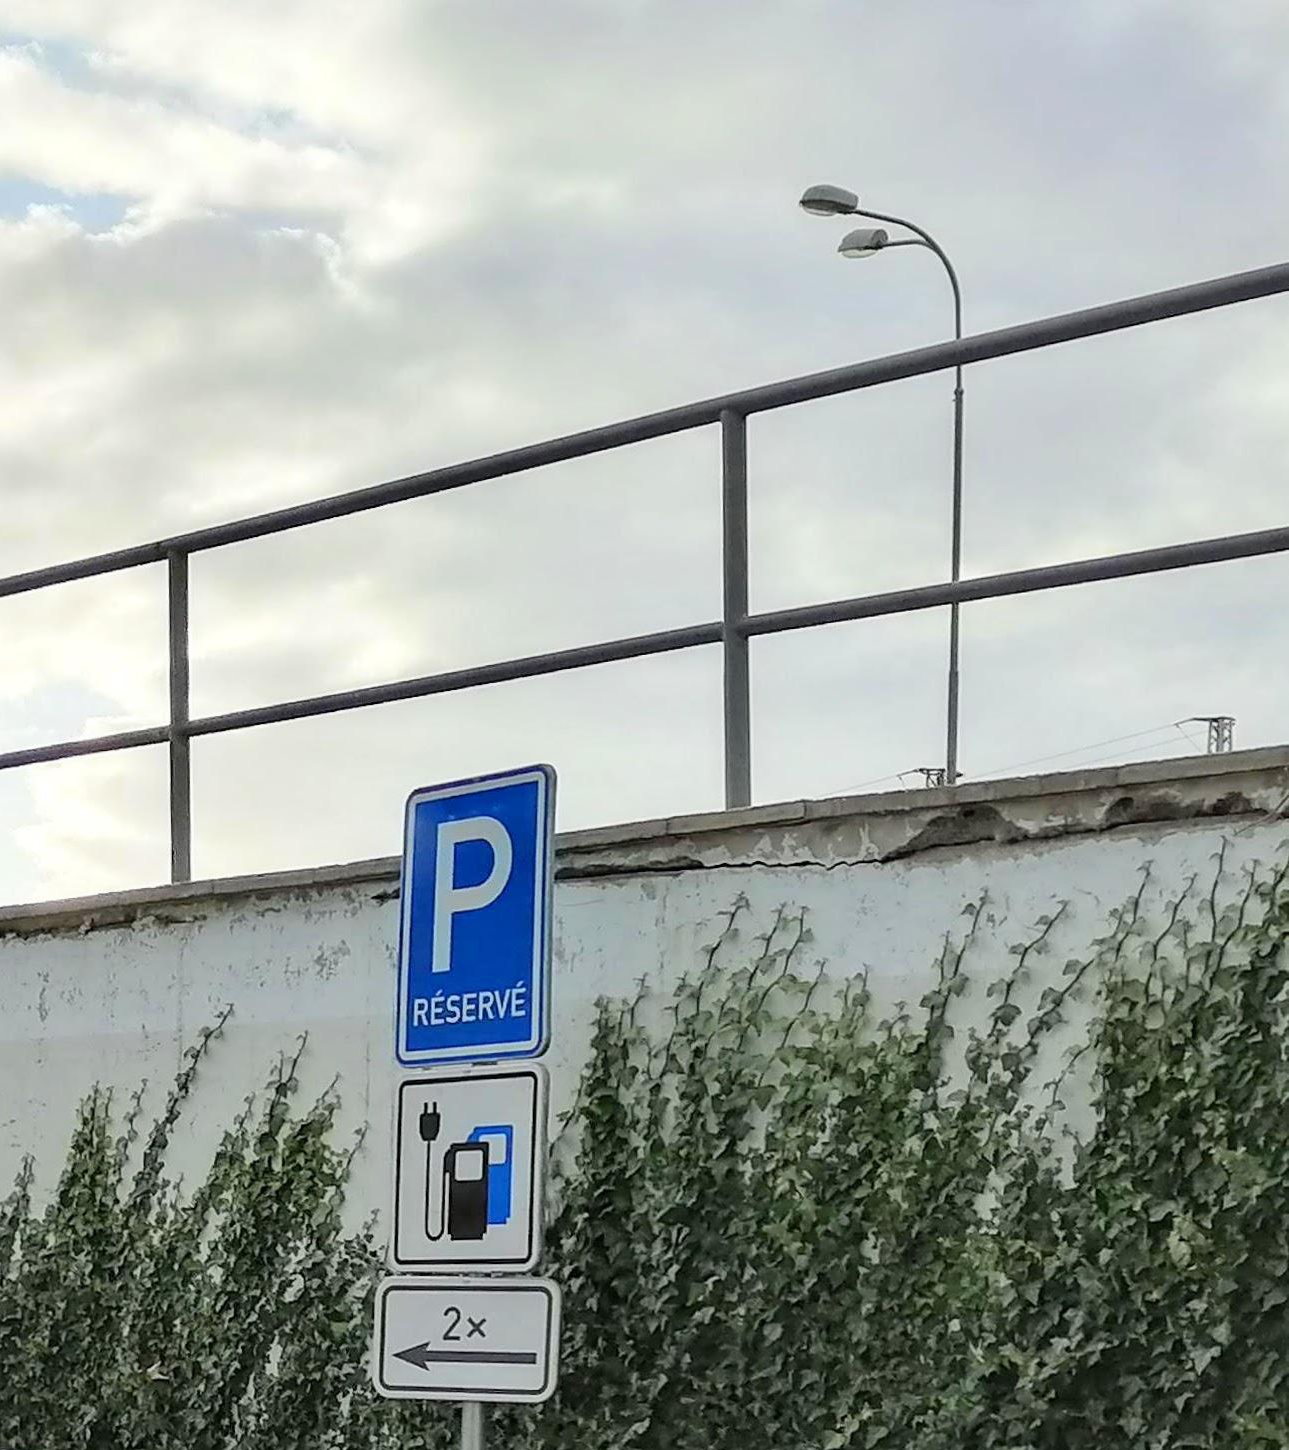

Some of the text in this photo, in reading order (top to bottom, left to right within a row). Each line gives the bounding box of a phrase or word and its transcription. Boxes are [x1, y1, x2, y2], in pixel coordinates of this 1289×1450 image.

[432, 815, 513, 973] P
[413, 980, 527, 1027] RÉSERVÉ
[443, 1306, 487, 1341] 2x
